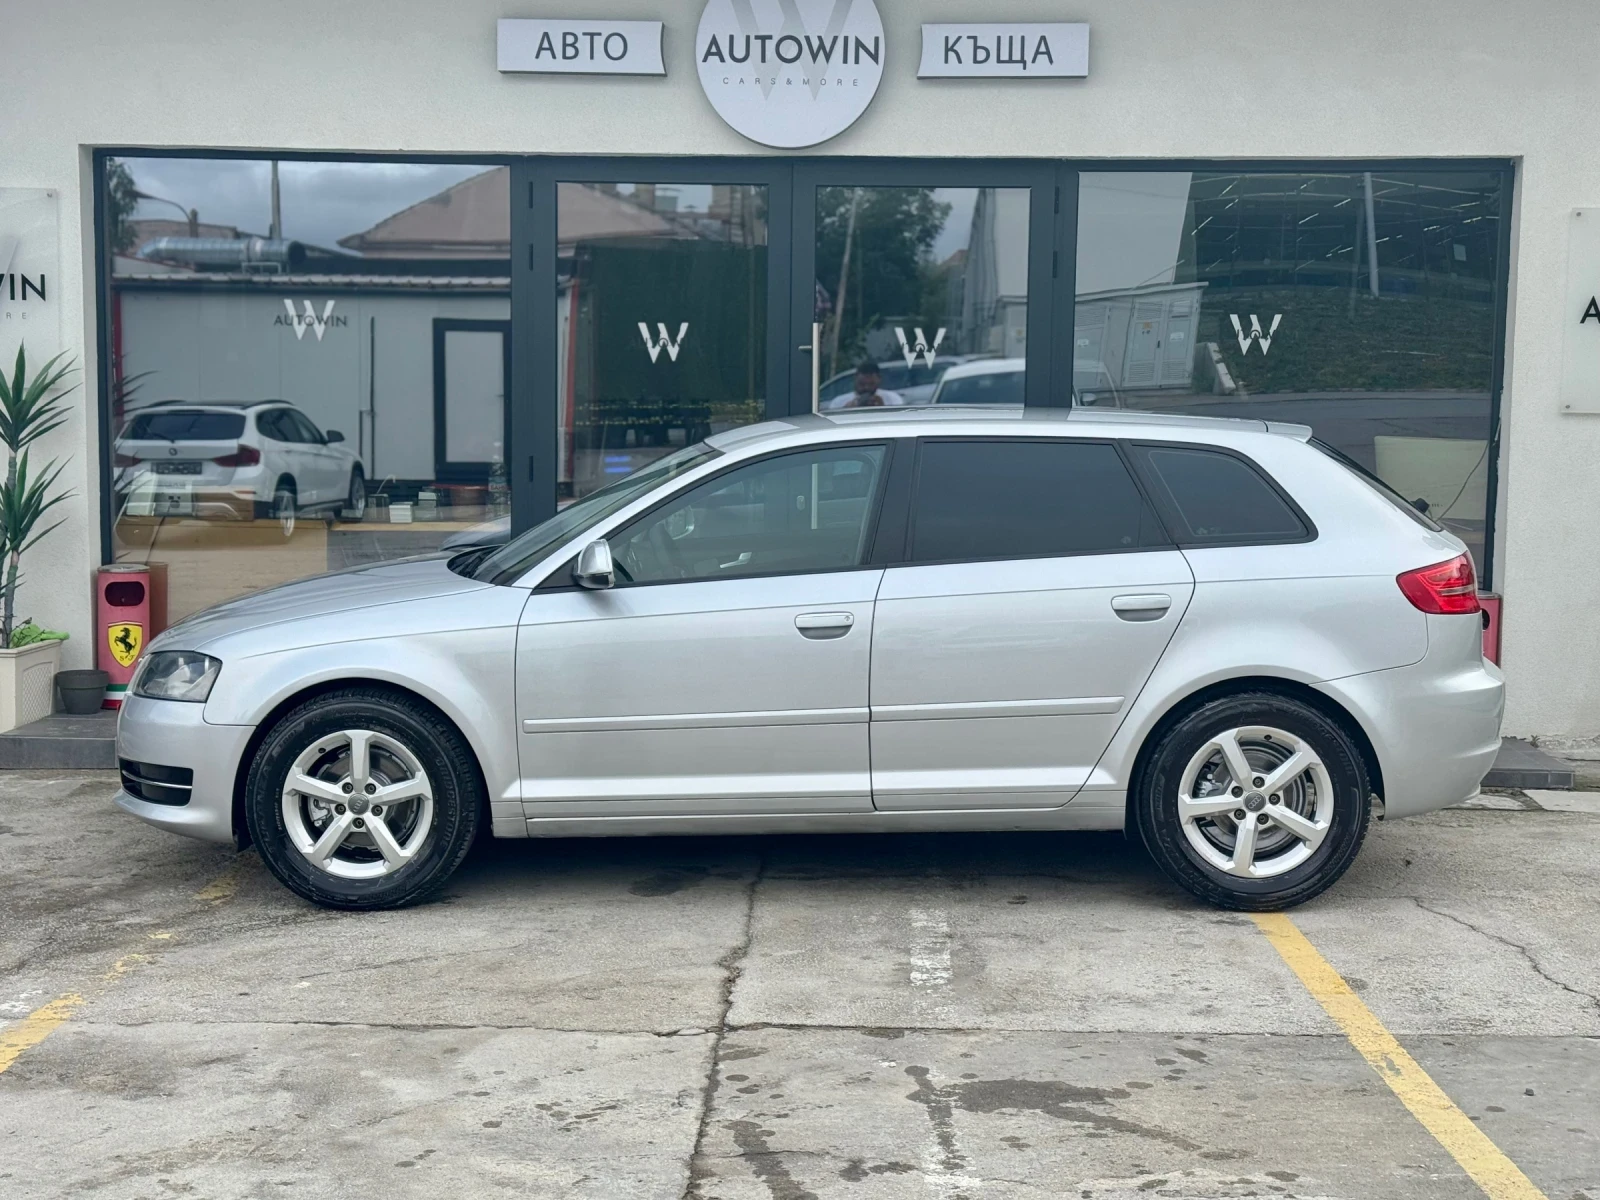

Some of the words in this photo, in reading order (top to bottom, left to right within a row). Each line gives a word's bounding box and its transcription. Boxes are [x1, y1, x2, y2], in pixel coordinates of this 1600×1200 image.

[534, 31, 628, 61] АВТО
[701, 33, 880, 66] AUTOWIN
[943, 35, 1054, 70] КЪЩА
[273, 314, 348, 327] AUTOWIN
